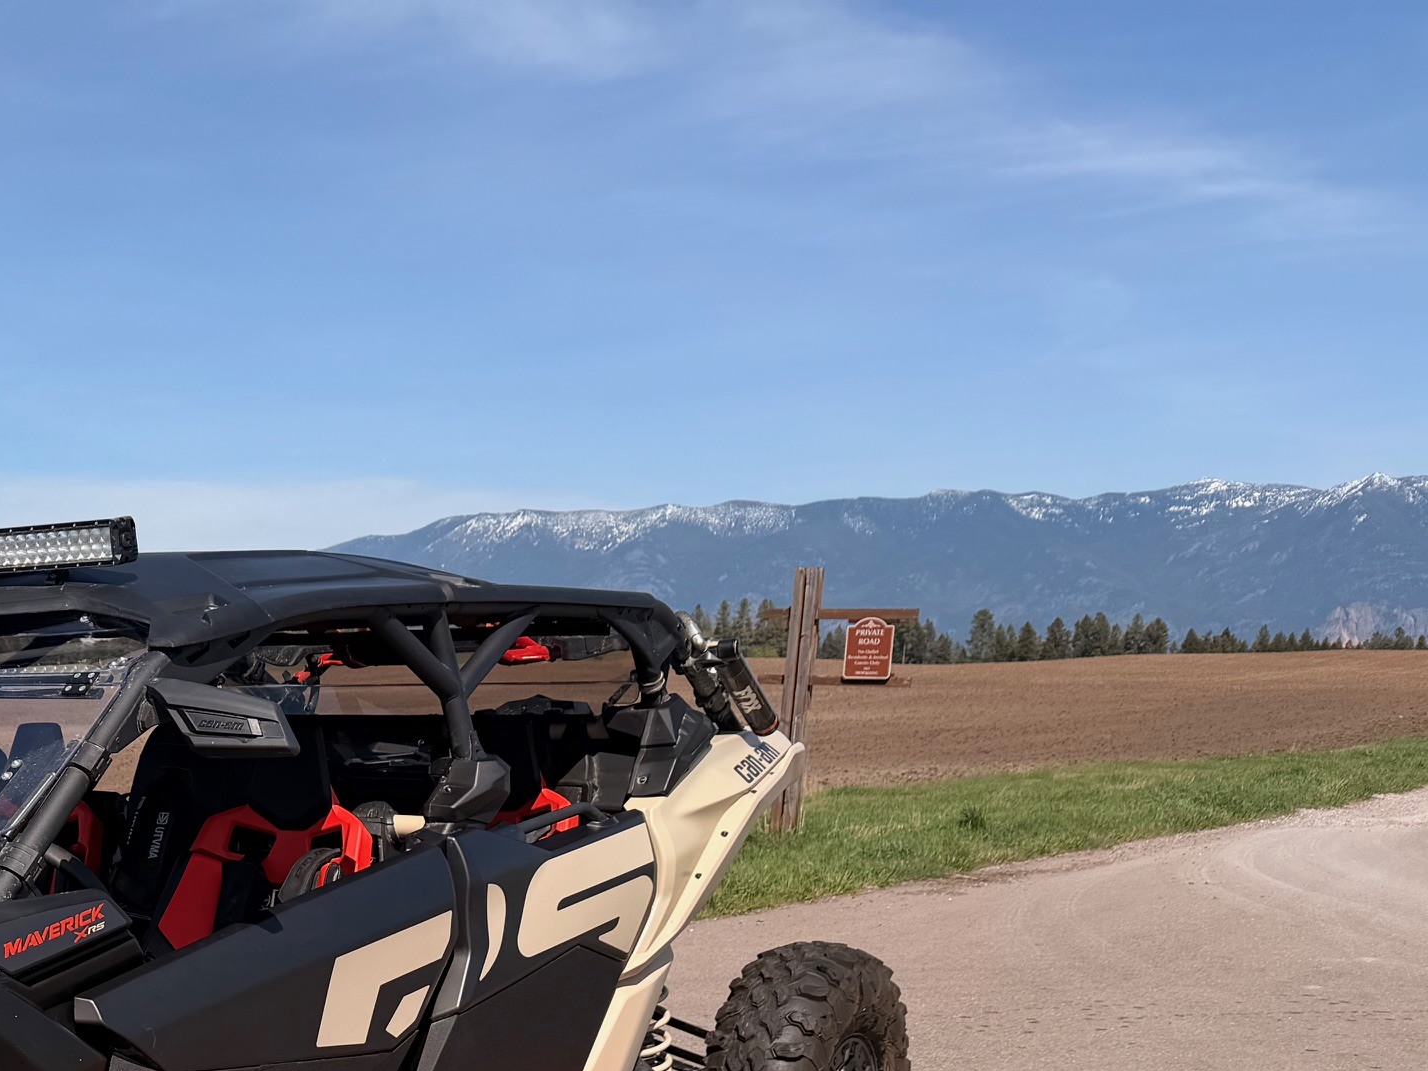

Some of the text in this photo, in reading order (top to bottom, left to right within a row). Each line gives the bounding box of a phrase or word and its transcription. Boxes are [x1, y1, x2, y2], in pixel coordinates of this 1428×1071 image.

[855, 628, 885, 636] PRIVATE
[858, 637, 881, 645] ROAD
[3, 902, 105, 959] MAVERICK
